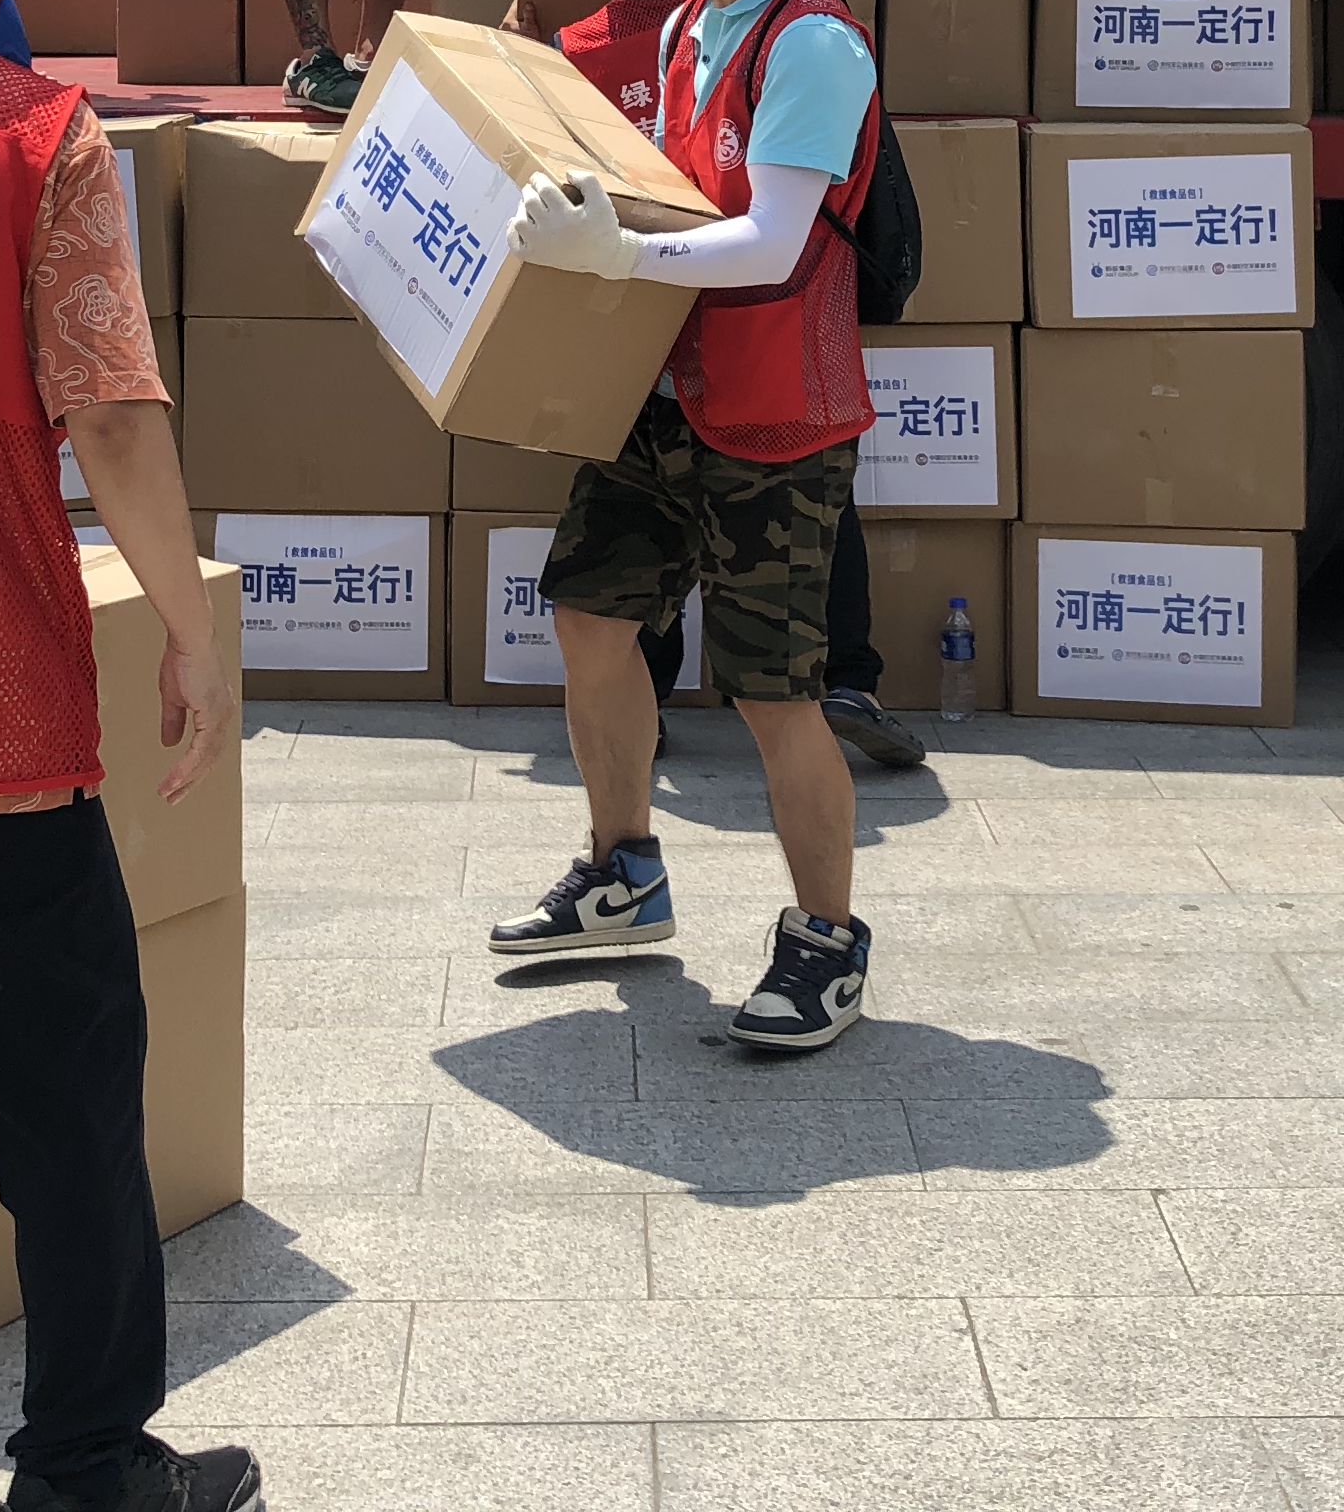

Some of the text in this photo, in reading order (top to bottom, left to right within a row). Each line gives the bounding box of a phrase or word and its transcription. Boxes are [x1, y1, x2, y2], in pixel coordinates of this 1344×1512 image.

[1092, 4, 1275, 44] 河南一定行!
[411, 138, 454, 191] 【救援食品包】
[351, 124, 488, 298] 河南一定行!
[1086, 203, 1277, 249] 河南一定行!
[659, 242, 692, 258] FILA
[1054, 588, 1245, 636] 河南一定行!
